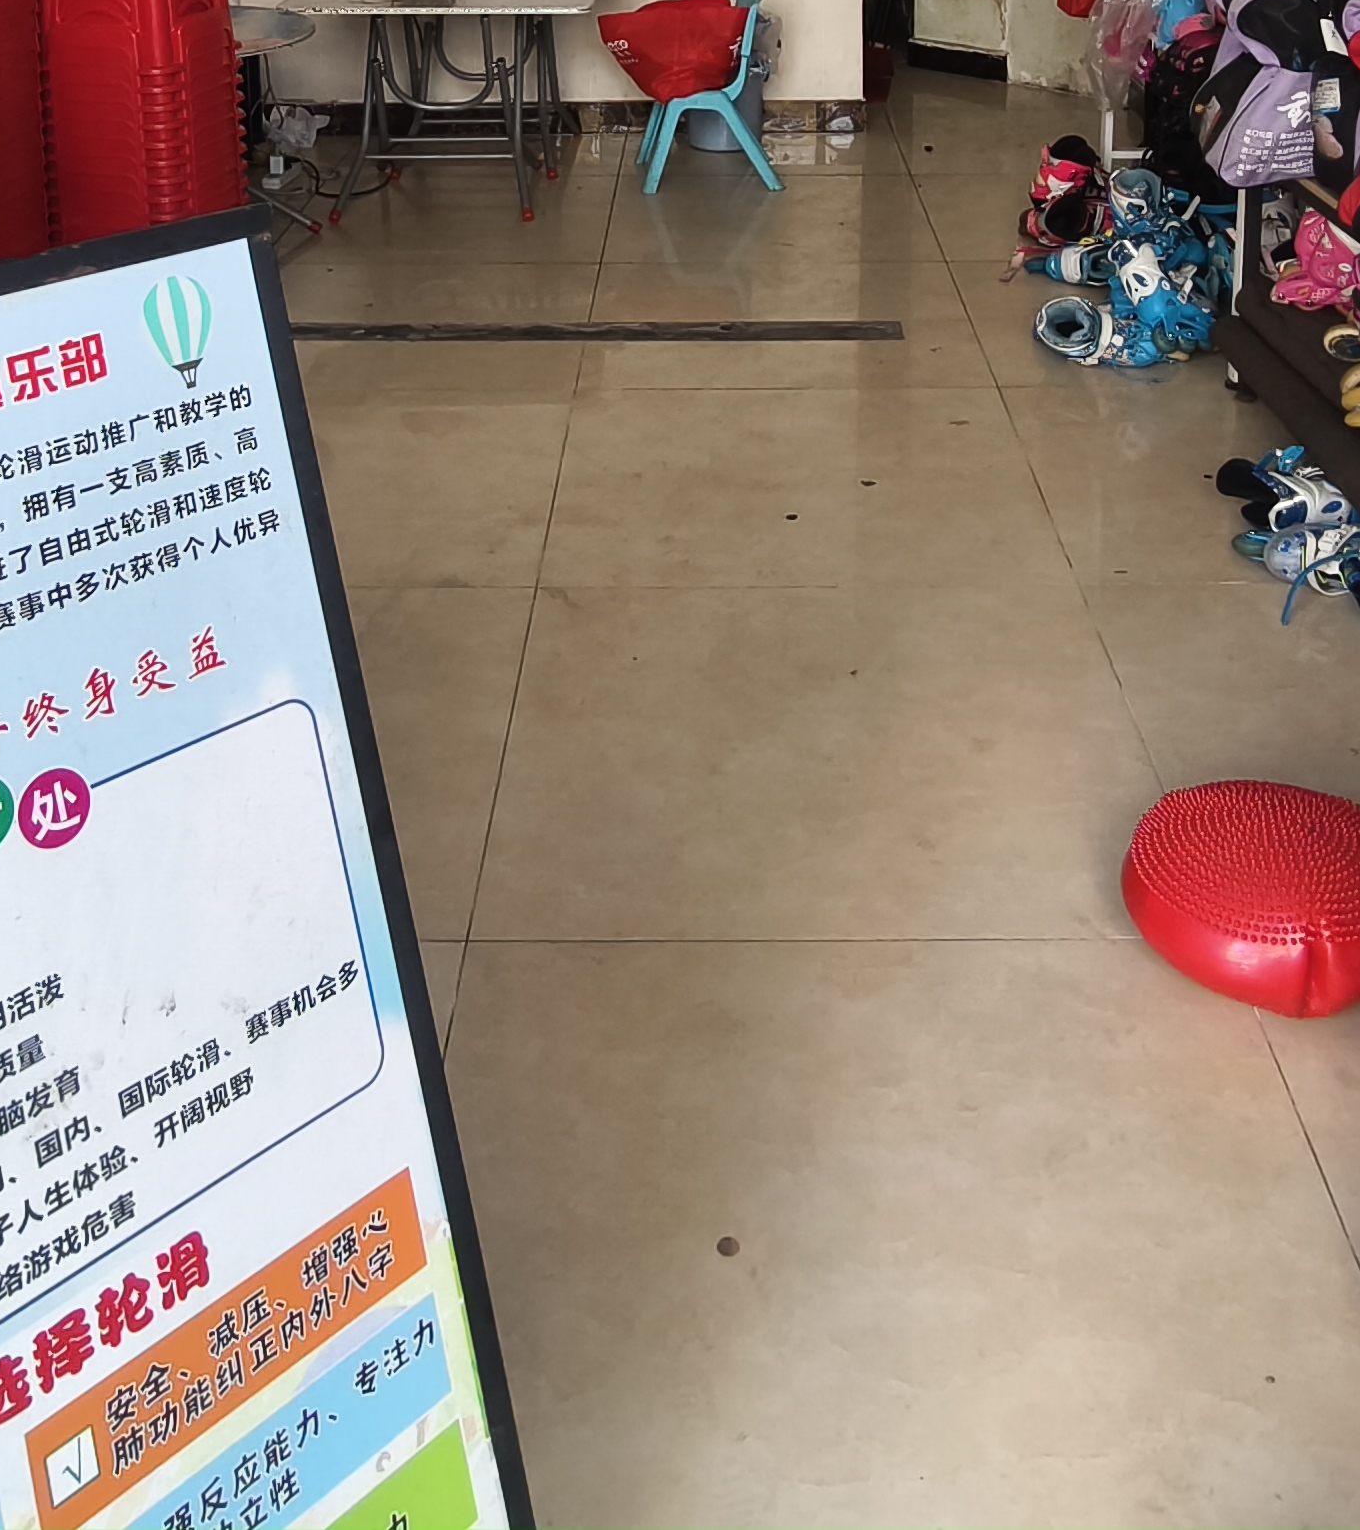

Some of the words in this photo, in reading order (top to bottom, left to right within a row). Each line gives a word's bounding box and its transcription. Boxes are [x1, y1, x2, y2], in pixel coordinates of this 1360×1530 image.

[112, 1242, 395, 1476] 肺功能纠正内外八字
